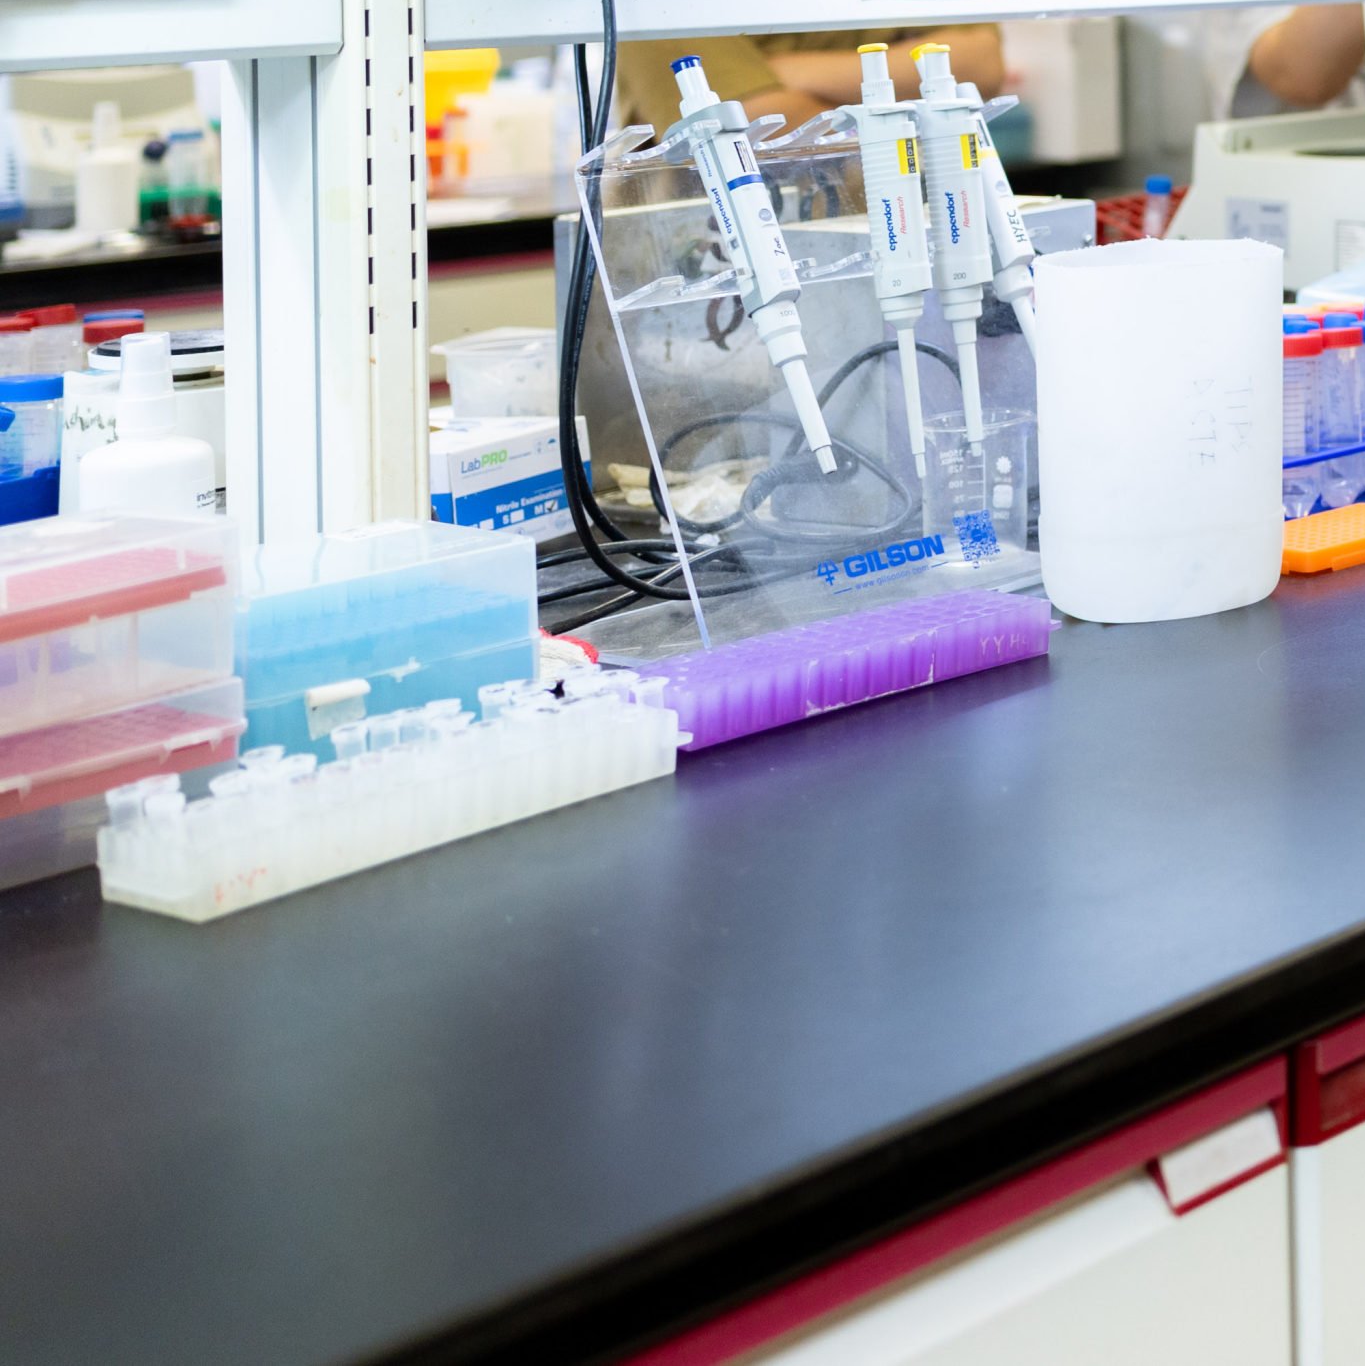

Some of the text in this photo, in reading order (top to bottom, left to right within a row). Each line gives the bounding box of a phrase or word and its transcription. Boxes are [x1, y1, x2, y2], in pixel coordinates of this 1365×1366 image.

[710, 187, 732, 235] eppendorf
[881, 197, 898, 252] eppendorf
[896, 196, 907, 235] Research
[944, 191, 961, 245] eppendorf
[959, 190, 970, 228] Research
[460, 449, 508, 474] LabPRO
[842, 533, 945, 578] GILSON
